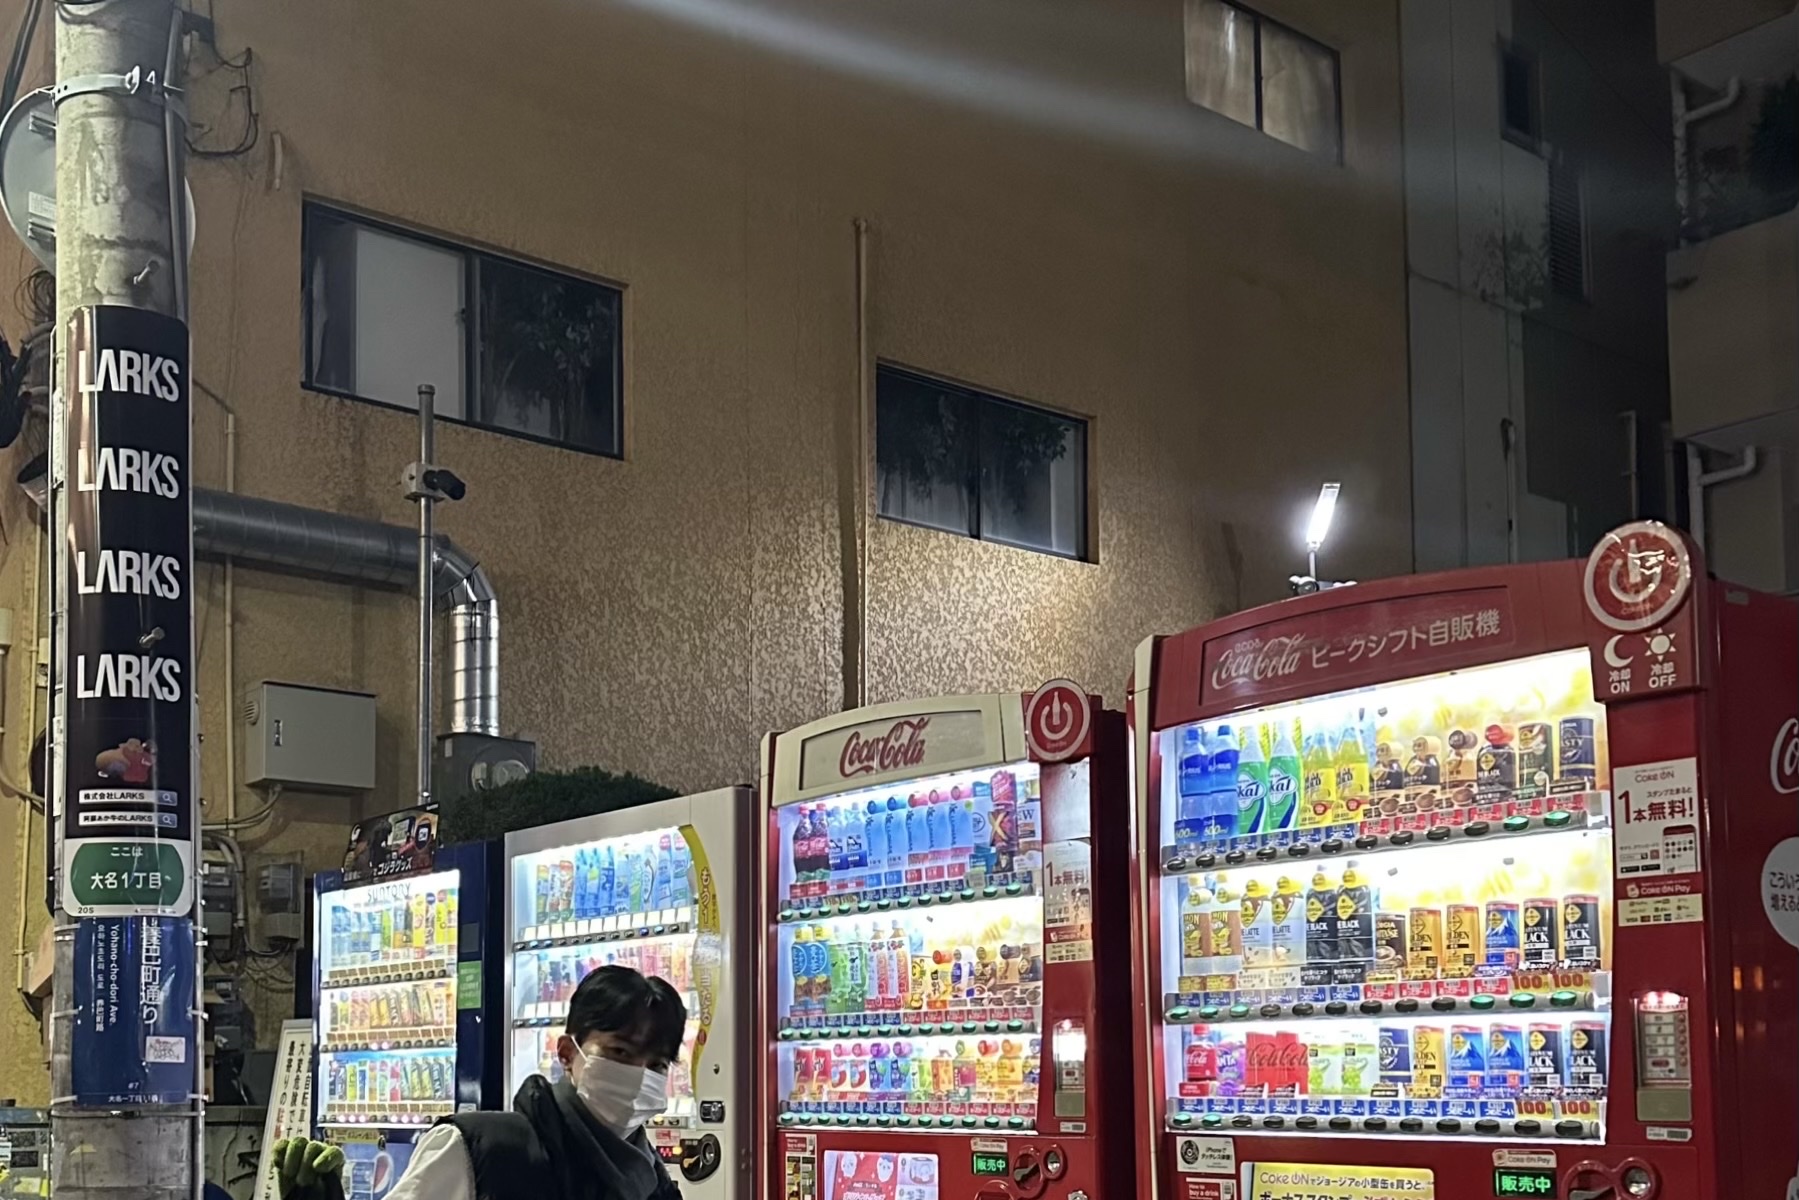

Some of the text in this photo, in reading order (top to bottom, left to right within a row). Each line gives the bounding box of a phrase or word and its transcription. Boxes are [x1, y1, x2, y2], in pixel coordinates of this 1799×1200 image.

[79, 349, 180, 402] LARKS
[78, 447, 180, 499] LARKS
[77, 549, 181, 600] LARKS
[77, 654, 181, 702] LARKS
[1649, 674, 1677, 688] OFF
[1610, 682, 1631, 694] ON
[111, 846, 143, 857] ここは
[91, 872, 161, 889] 大名1丁目
[977, 1159, 1006, 1172] 販売中
[1260, 1172, 1289, 1185] Coke
[1501, 1175, 1551, 1193] 販売中
